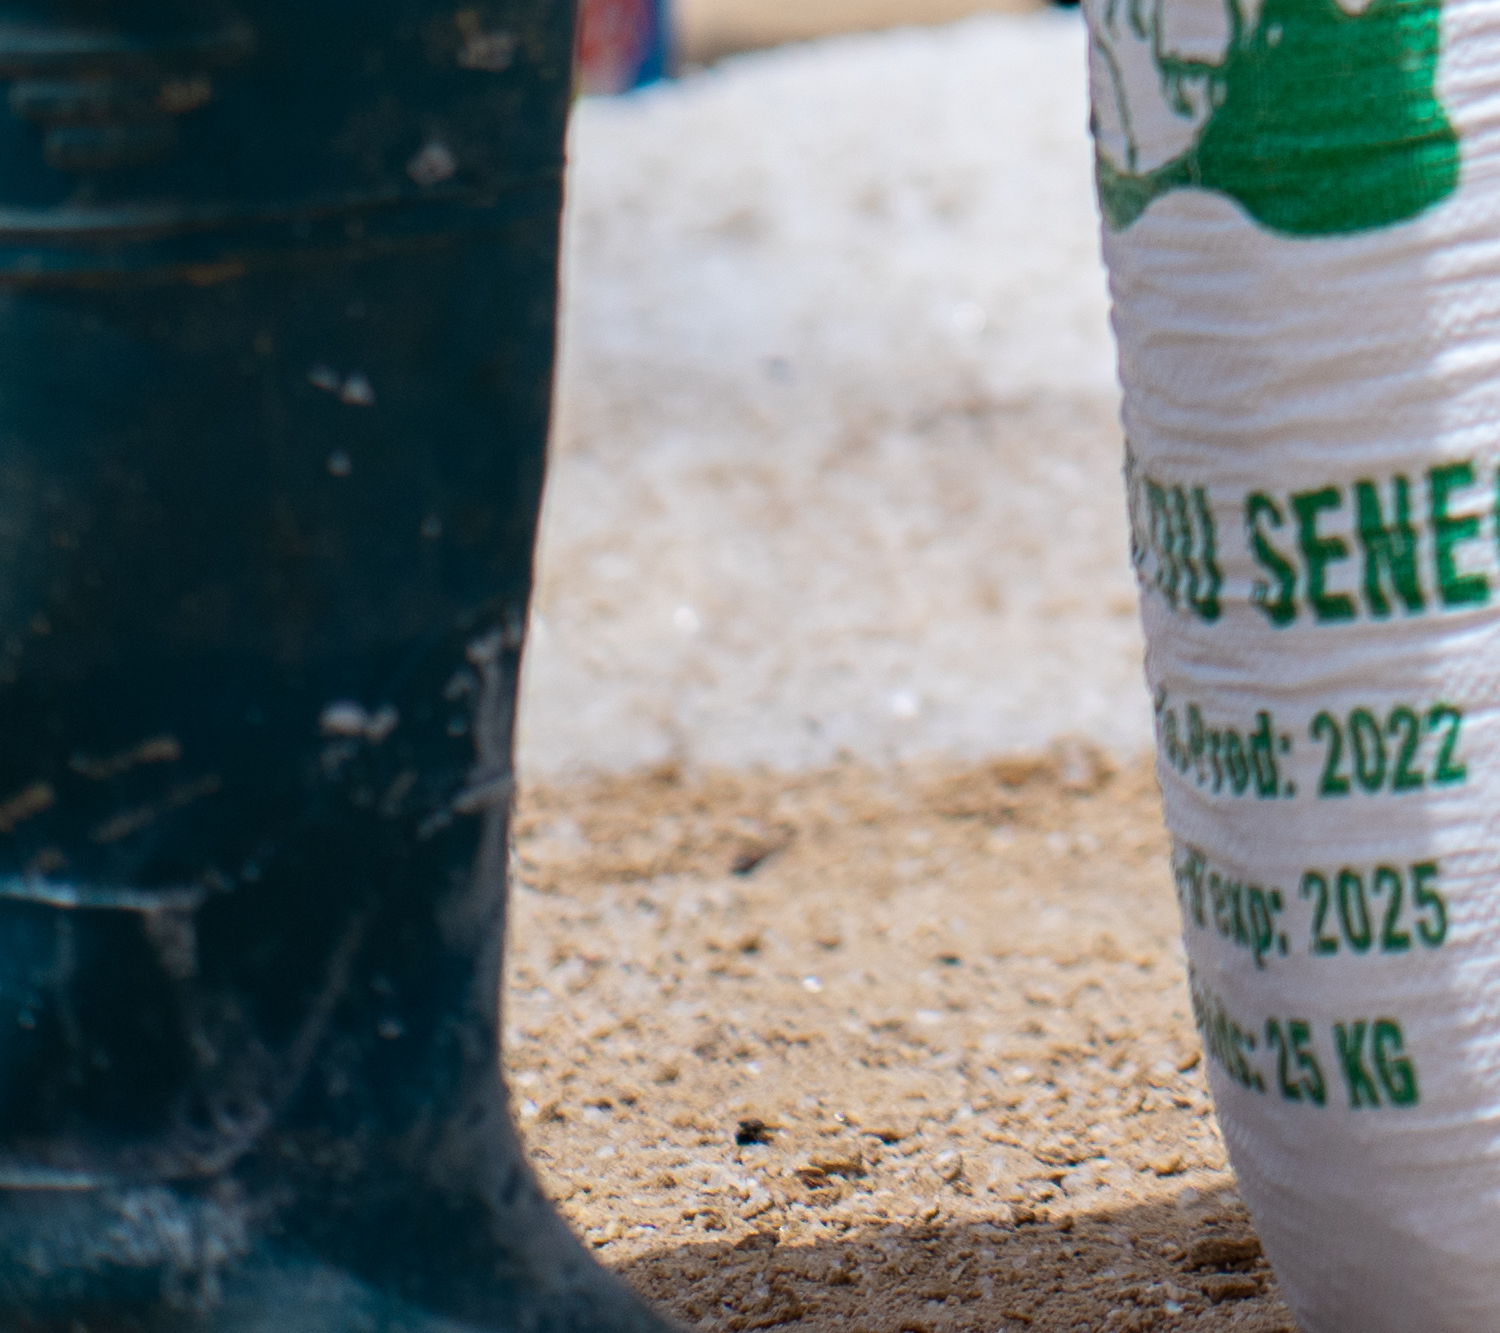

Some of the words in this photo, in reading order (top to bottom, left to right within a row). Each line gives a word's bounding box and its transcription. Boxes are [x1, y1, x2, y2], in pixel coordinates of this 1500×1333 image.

[1308, 699, 1467, 800] 2022
[1301, 860, 1448, 955] 2025
[1332, 1018, 1418, 1109] KG
